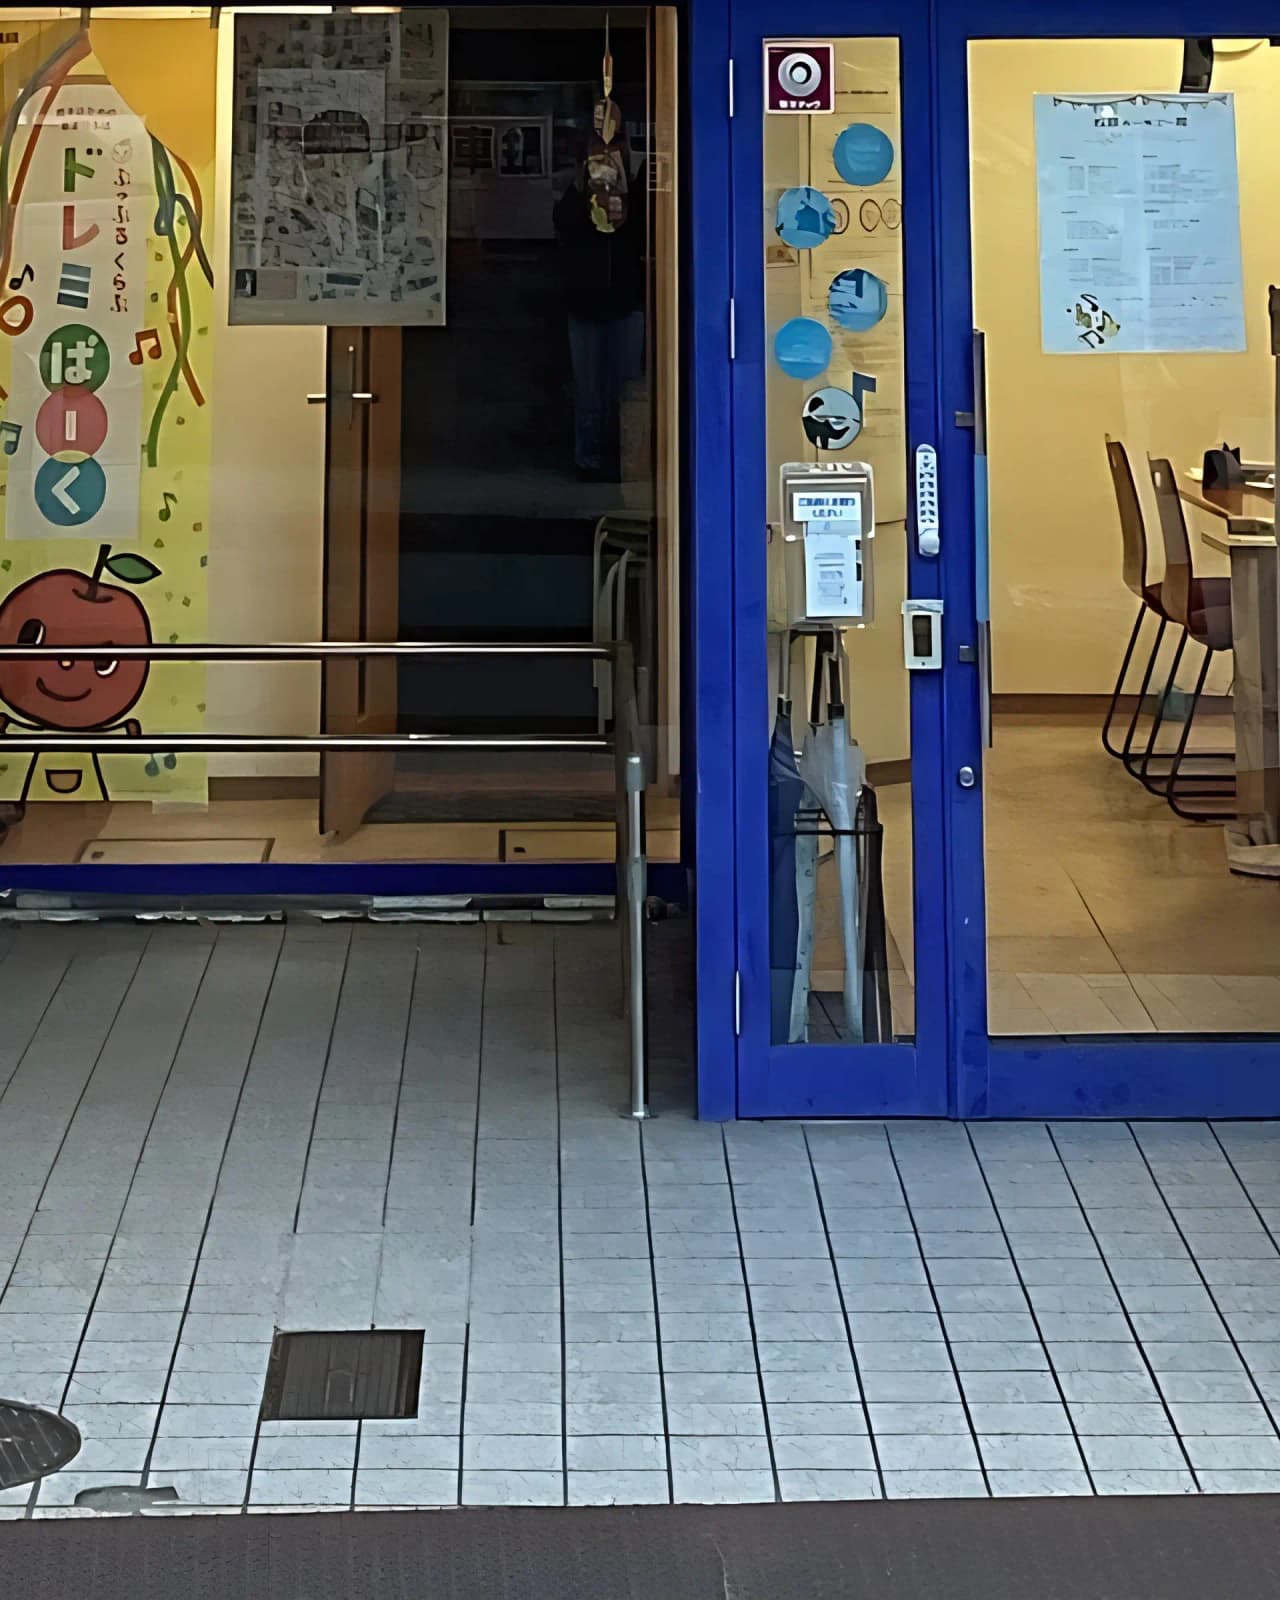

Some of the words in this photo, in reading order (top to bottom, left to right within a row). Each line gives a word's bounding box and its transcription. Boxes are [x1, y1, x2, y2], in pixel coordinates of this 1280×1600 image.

[50, 147, 104, 516] ドレミぱーく
